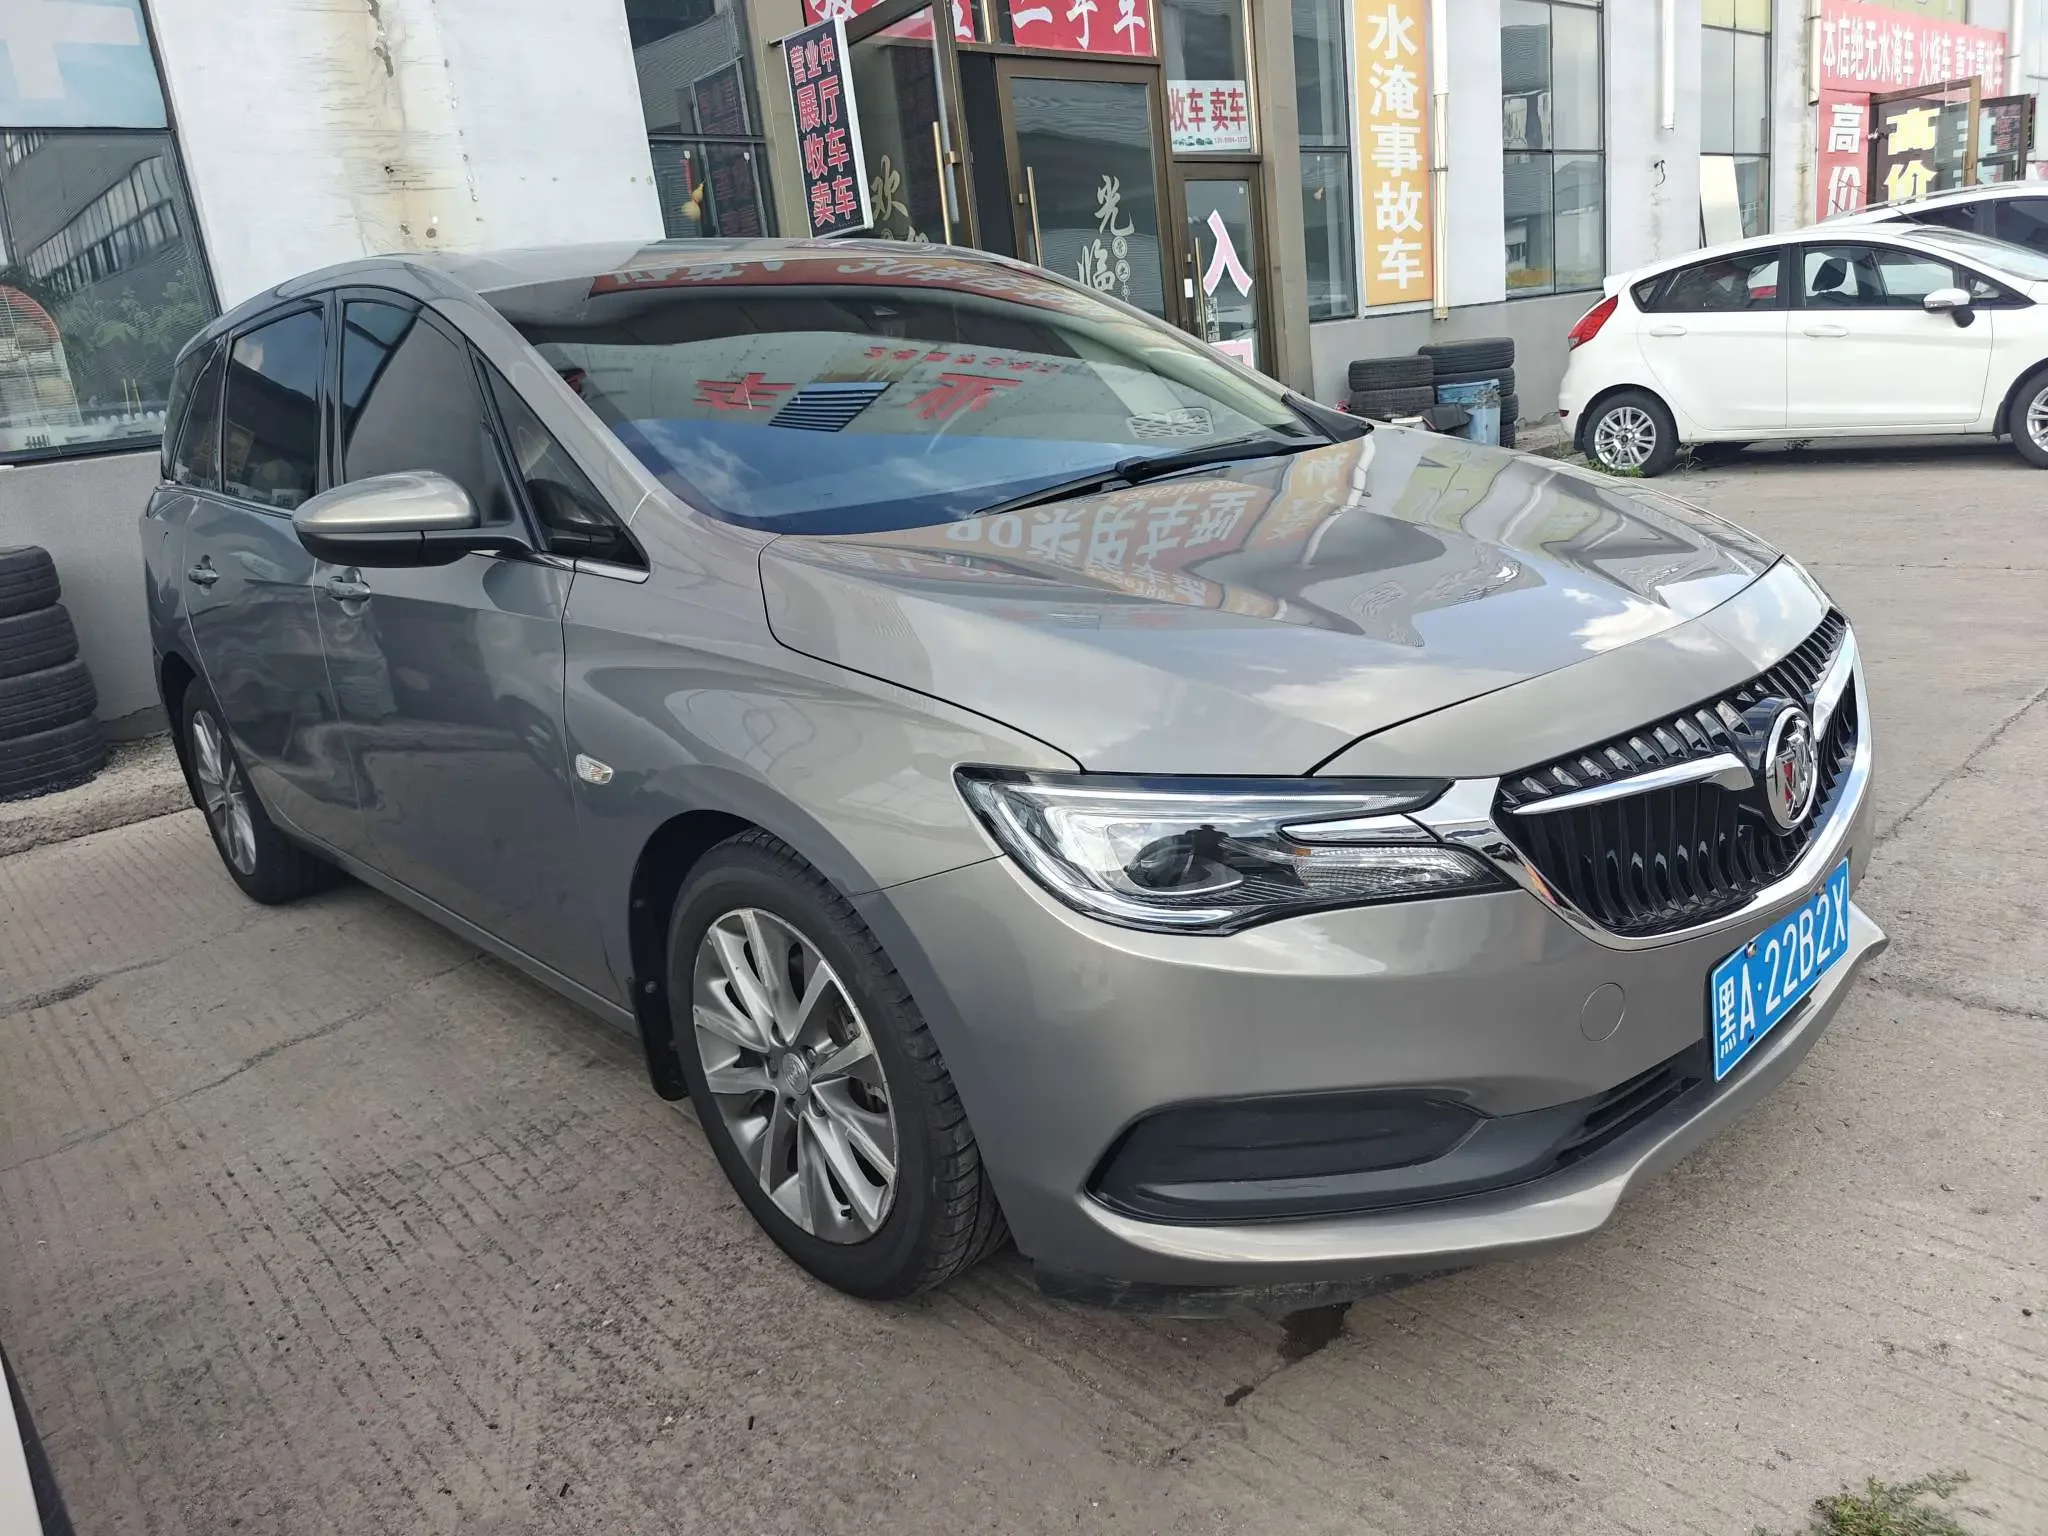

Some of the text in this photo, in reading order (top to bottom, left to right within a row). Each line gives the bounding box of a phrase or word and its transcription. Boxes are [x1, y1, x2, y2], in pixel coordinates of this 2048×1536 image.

[790, 33, 835, 85] 营业中
[797, 75, 840, 133] 展厅
[1169, 87, 1247, 132] 收车 卖车
[803, 127, 850, 180] 收车
[1367, 4, 1424, 289] 水淹事故车
[1827, 103, 1864, 217] 高价
[811, 175, 857, 228] 卖车
